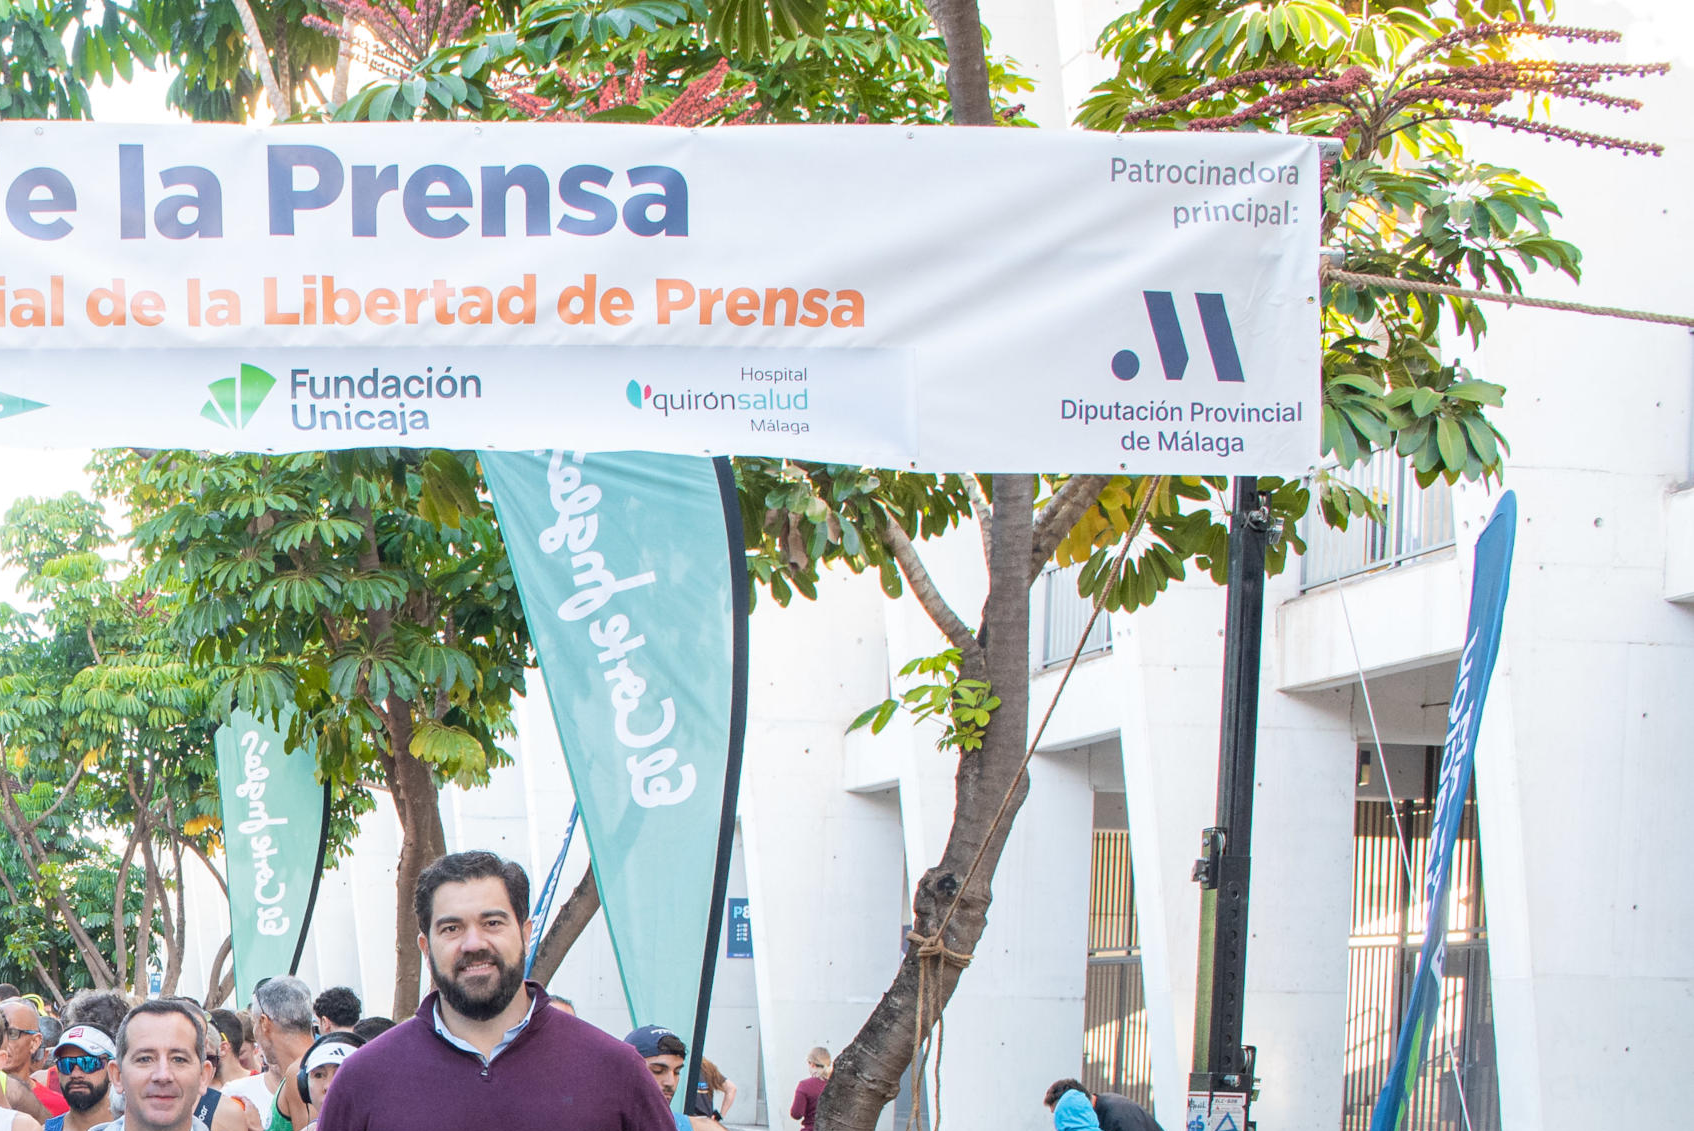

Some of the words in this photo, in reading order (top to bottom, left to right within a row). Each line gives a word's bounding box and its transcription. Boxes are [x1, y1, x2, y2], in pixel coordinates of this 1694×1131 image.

[1110, 157, 1299, 186] Patrocinadora
[118, 143, 223, 240] la
[267, 143, 690, 239] Prensa
[1173, 197, 1299, 229] principal:
[84, 277, 167, 327] de
[186, 277, 242, 327] la
[262, 273, 537, 327] Libertad
[556, 273, 635, 327] de
[655, 277, 865, 328] Prensa
[289, 366, 483, 400] Fundación
[740, 367, 807, 384] Hospital
[652, 388, 808, 417] quirónsalud
[1060, 399, 1183, 425] Diputación
[1190, 401, 1303, 423] Provincial
[289, 403, 430, 436] Unicaja
[750, 418, 810, 436] Málaga
[1120, 430, 1150, 451] de
[1157, 430, 1245, 457] Málaga
